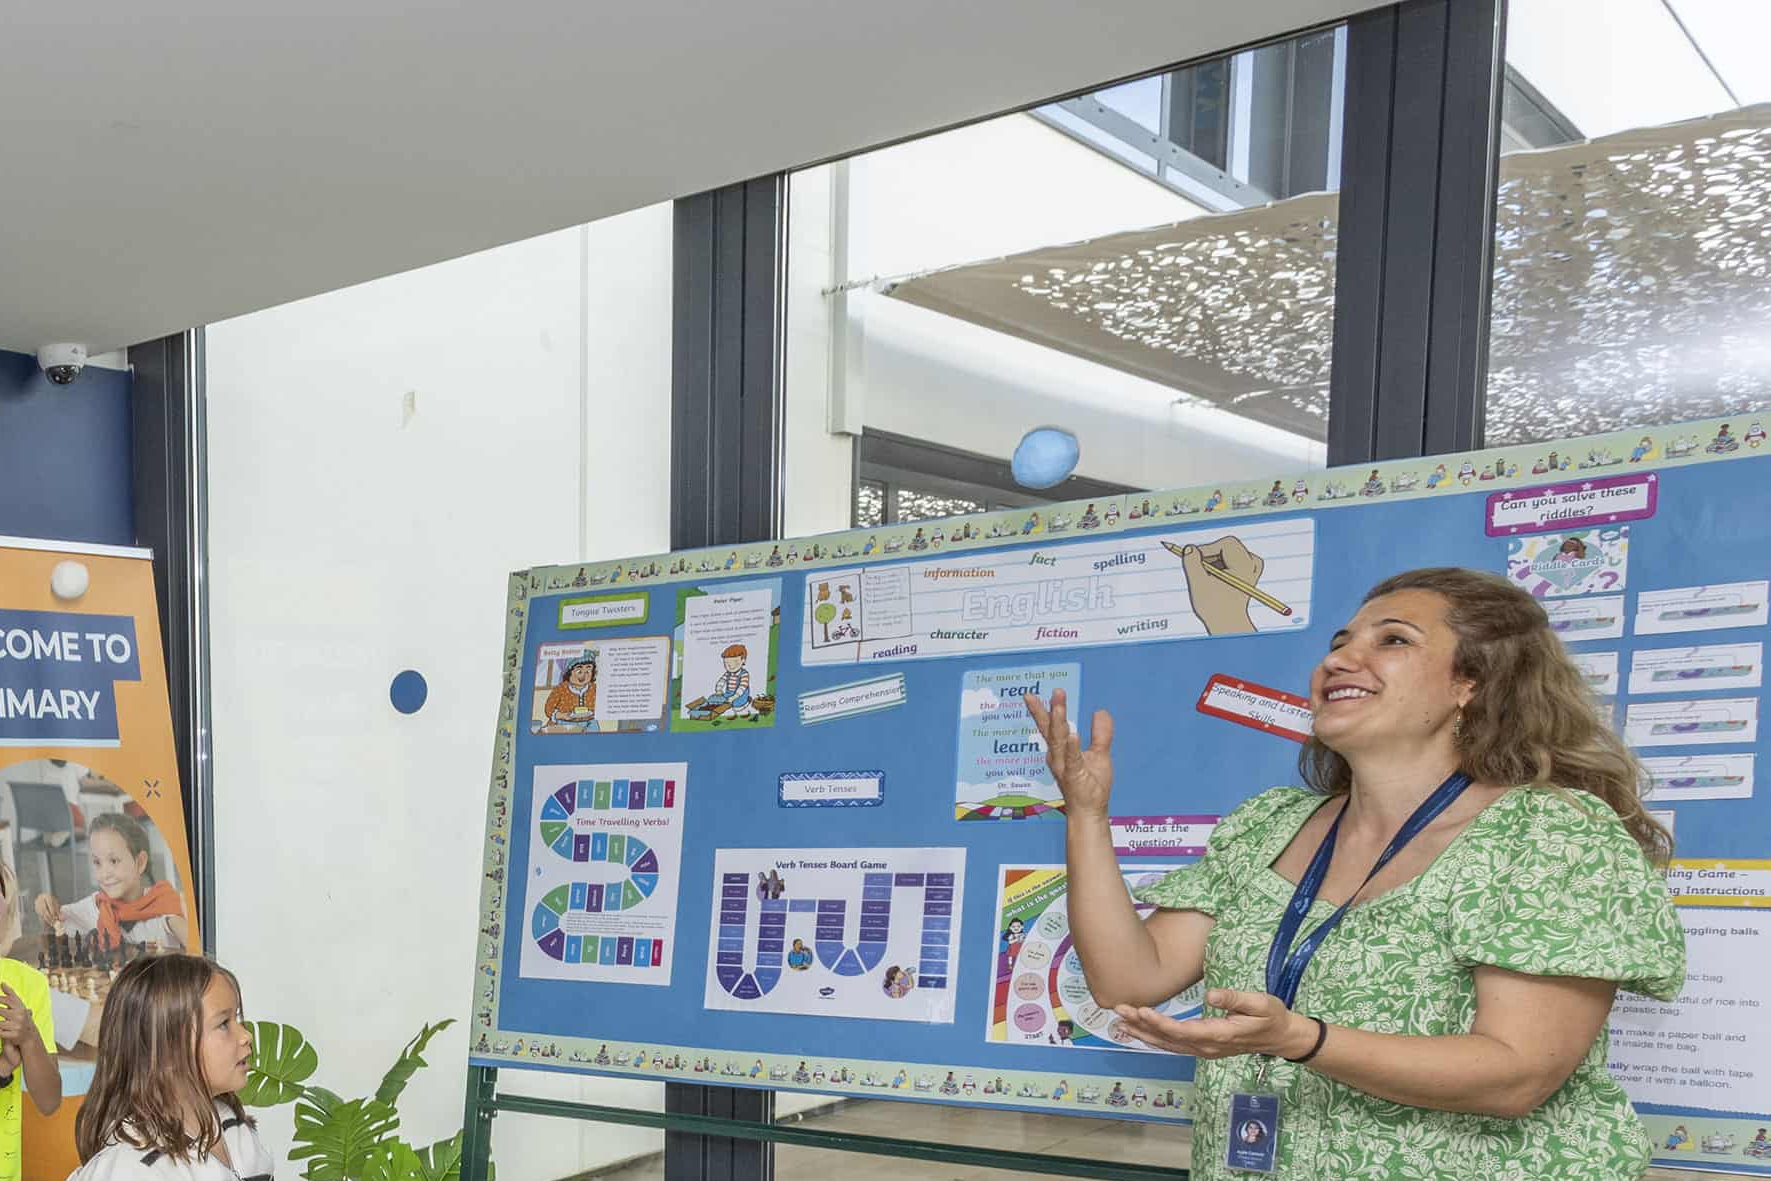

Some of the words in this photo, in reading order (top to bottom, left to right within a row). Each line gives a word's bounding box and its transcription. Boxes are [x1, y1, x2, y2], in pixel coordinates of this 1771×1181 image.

[1500, 499, 1527, 511] Can
[1532, 496, 1557, 509] you
[1561, 490, 1596, 504] solve
[1600, 485, 1637, 498] these
[1539, 504, 1594, 521] riddles?
[922, 566, 996, 581] information
[1027, 551, 1057, 568] fact
[1092, 551, 1147, 572] spelling
[960, 576, 1116, 626] English
[929, 627, 990, 642] character
[1034, 626, 1079, 642] fiction
[1116, 616, 1169, 637] writing
[85, 633, 132, 664] TO
[872, 642, 918, 660] reading
[999, 681, 1041, 698] read
[993, 739, 1041, 754] learn
[1124, 823, 1155, 833] What
[1157, 823, 1168, 833] is
[1170, 823, 1189, 833] the
[1128, 837, 1183, 850] question?
[775, 860, 797, 870] Verb
[799, 860, 828, 870] Tenses
[830, 860, 858, 870] Board
[860, 861, 887, 870] Game
[1697, 869, 1736, 880] Game
[1685, 885, 1765, 897] Instructions
[1683, 927, 1726, 937] uggling
[1730, 926, 1759, 936] balls
